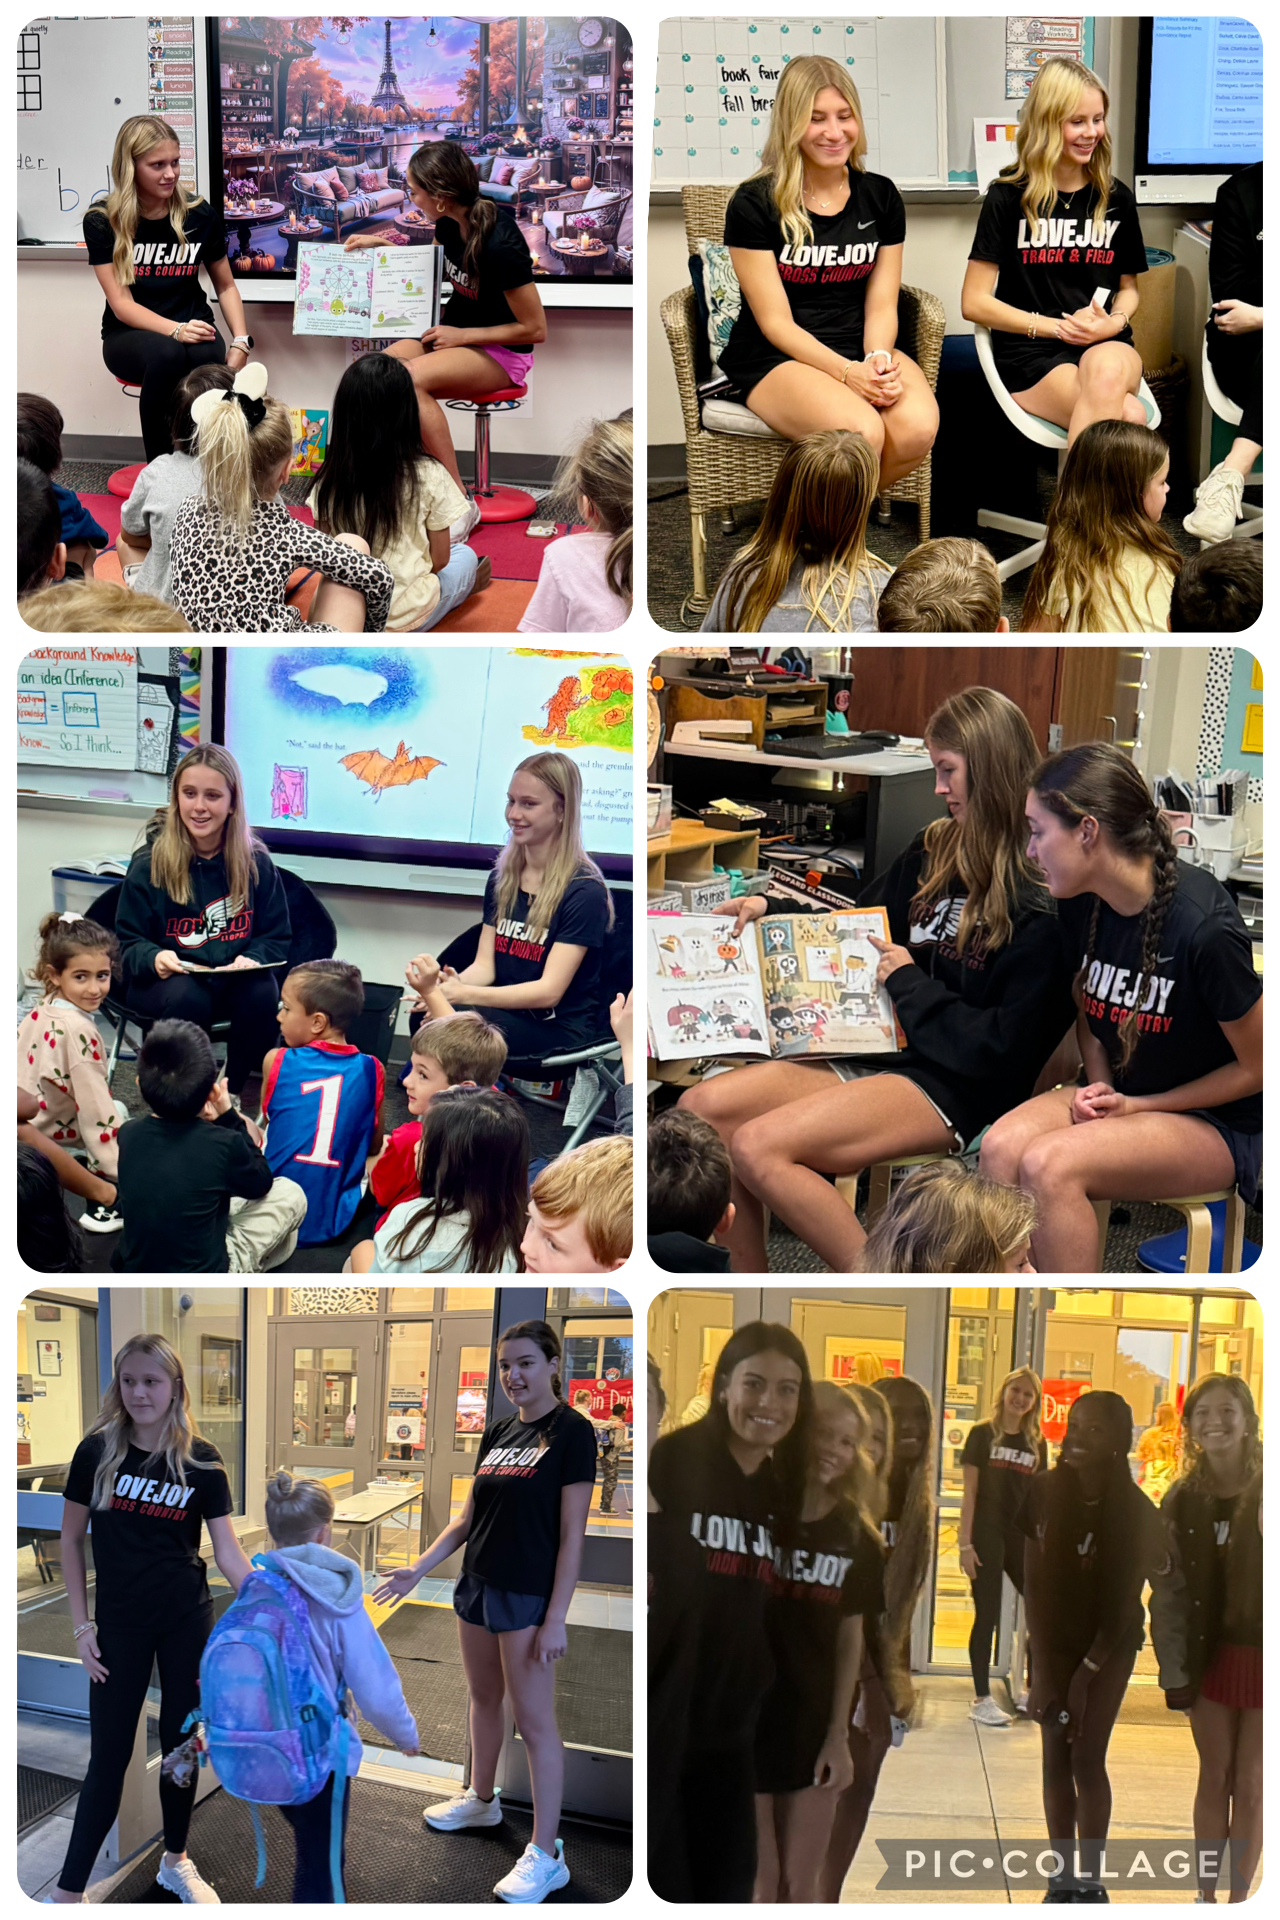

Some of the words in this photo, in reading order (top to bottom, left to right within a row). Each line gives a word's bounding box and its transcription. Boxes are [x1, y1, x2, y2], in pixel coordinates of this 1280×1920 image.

[166, 49, 190, 57] Reading
[721, 66, 751, 82] book
[758, 64, 780, 80] fair
[722, 95, 744, 112] fall
[751, 95, 776, 112] brea
[1017, 218, 1121, 249] LOVEJOY
[133, 242, 202, 265] OVEJOY
[779, 241, 879, 267] LOVEJOY
[1022, 248, 1065, 264] TRACK
[1069, 248, 1080, 263] &
[1085, 250, 1115, 264] FIELD
[134, 265, 152, 276] OSS
[155, 265, 199, 276] COUNTRY
[21, 673, 35, 684] an
[41, 668, 63, 685] idea
[60, 732, 73, 751] So
[73, 734, 82, 751] I
[592, 760, 604, 769] the
[594, 800, 629, 810] disgusted
[1084, 994, 1105, 1019] OSS
[1110, 1005, 1173, 1033] CONTRY
[294, 1074, 344, 1167] 1
[110, 1497, 137, 1513] ROSS
[139, 1503, 188, 1521] COUNTRY
